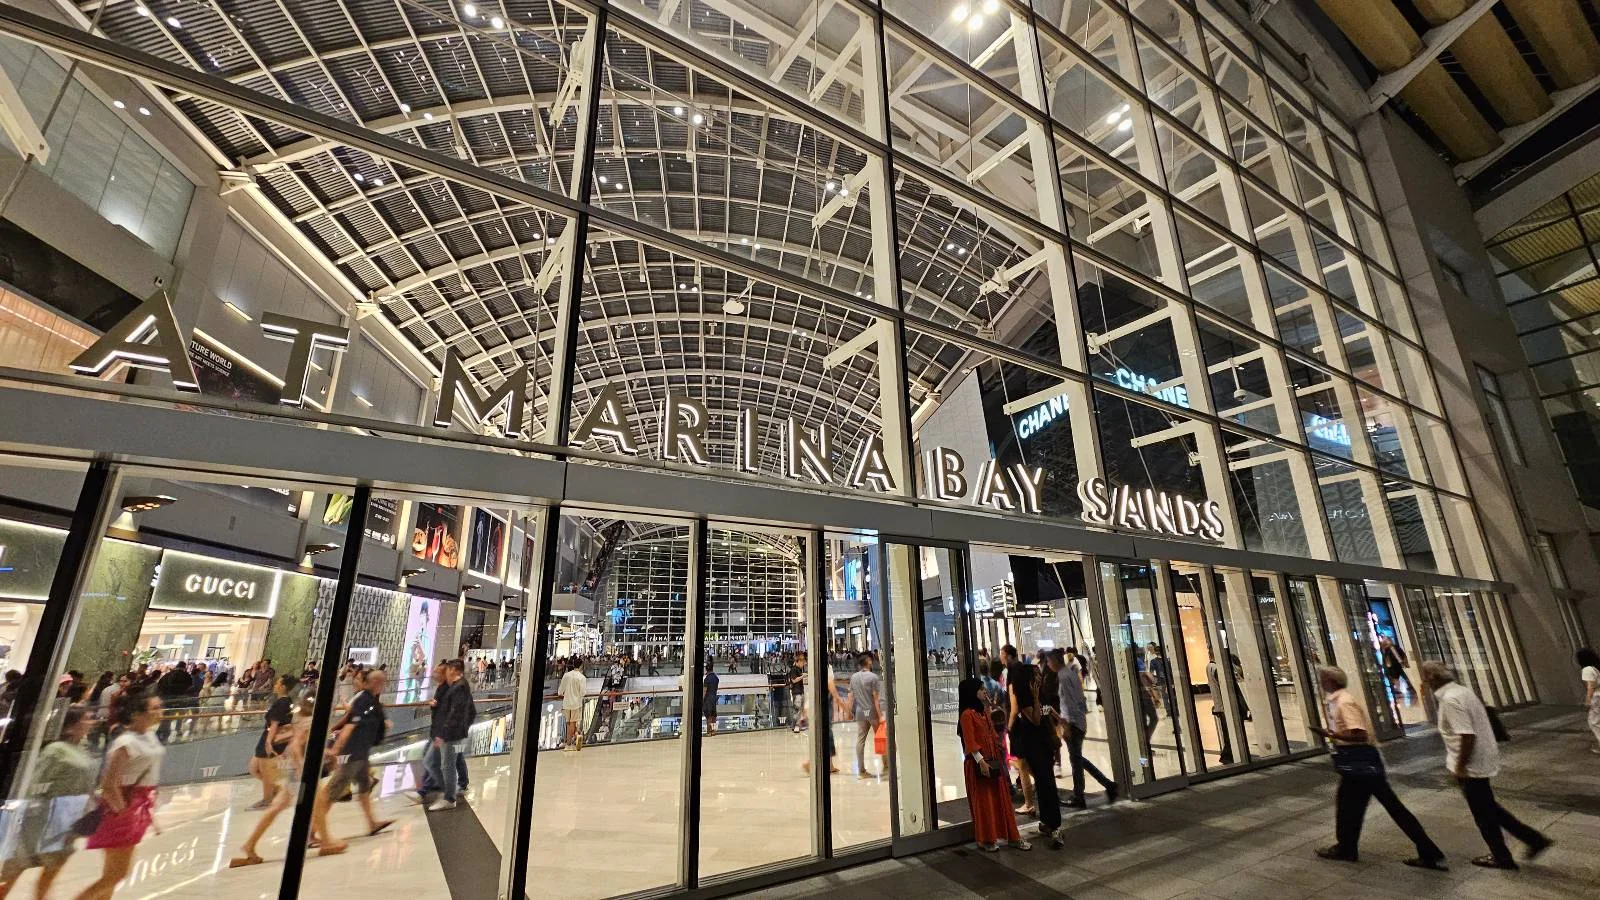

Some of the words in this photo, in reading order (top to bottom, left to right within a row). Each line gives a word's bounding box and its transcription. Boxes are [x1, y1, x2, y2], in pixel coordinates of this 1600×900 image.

[190, 340, 210, 357] TURE
[209, 351, 232, 370] WORLD
[68, 290, 350, 405] AT
[434, 346, 897, 491] MARINA
[928, 446, 1047, 514] BAY
[1078, 477, 1225, 541] SANDS
[185, 573, 256, 600] GUCCI
